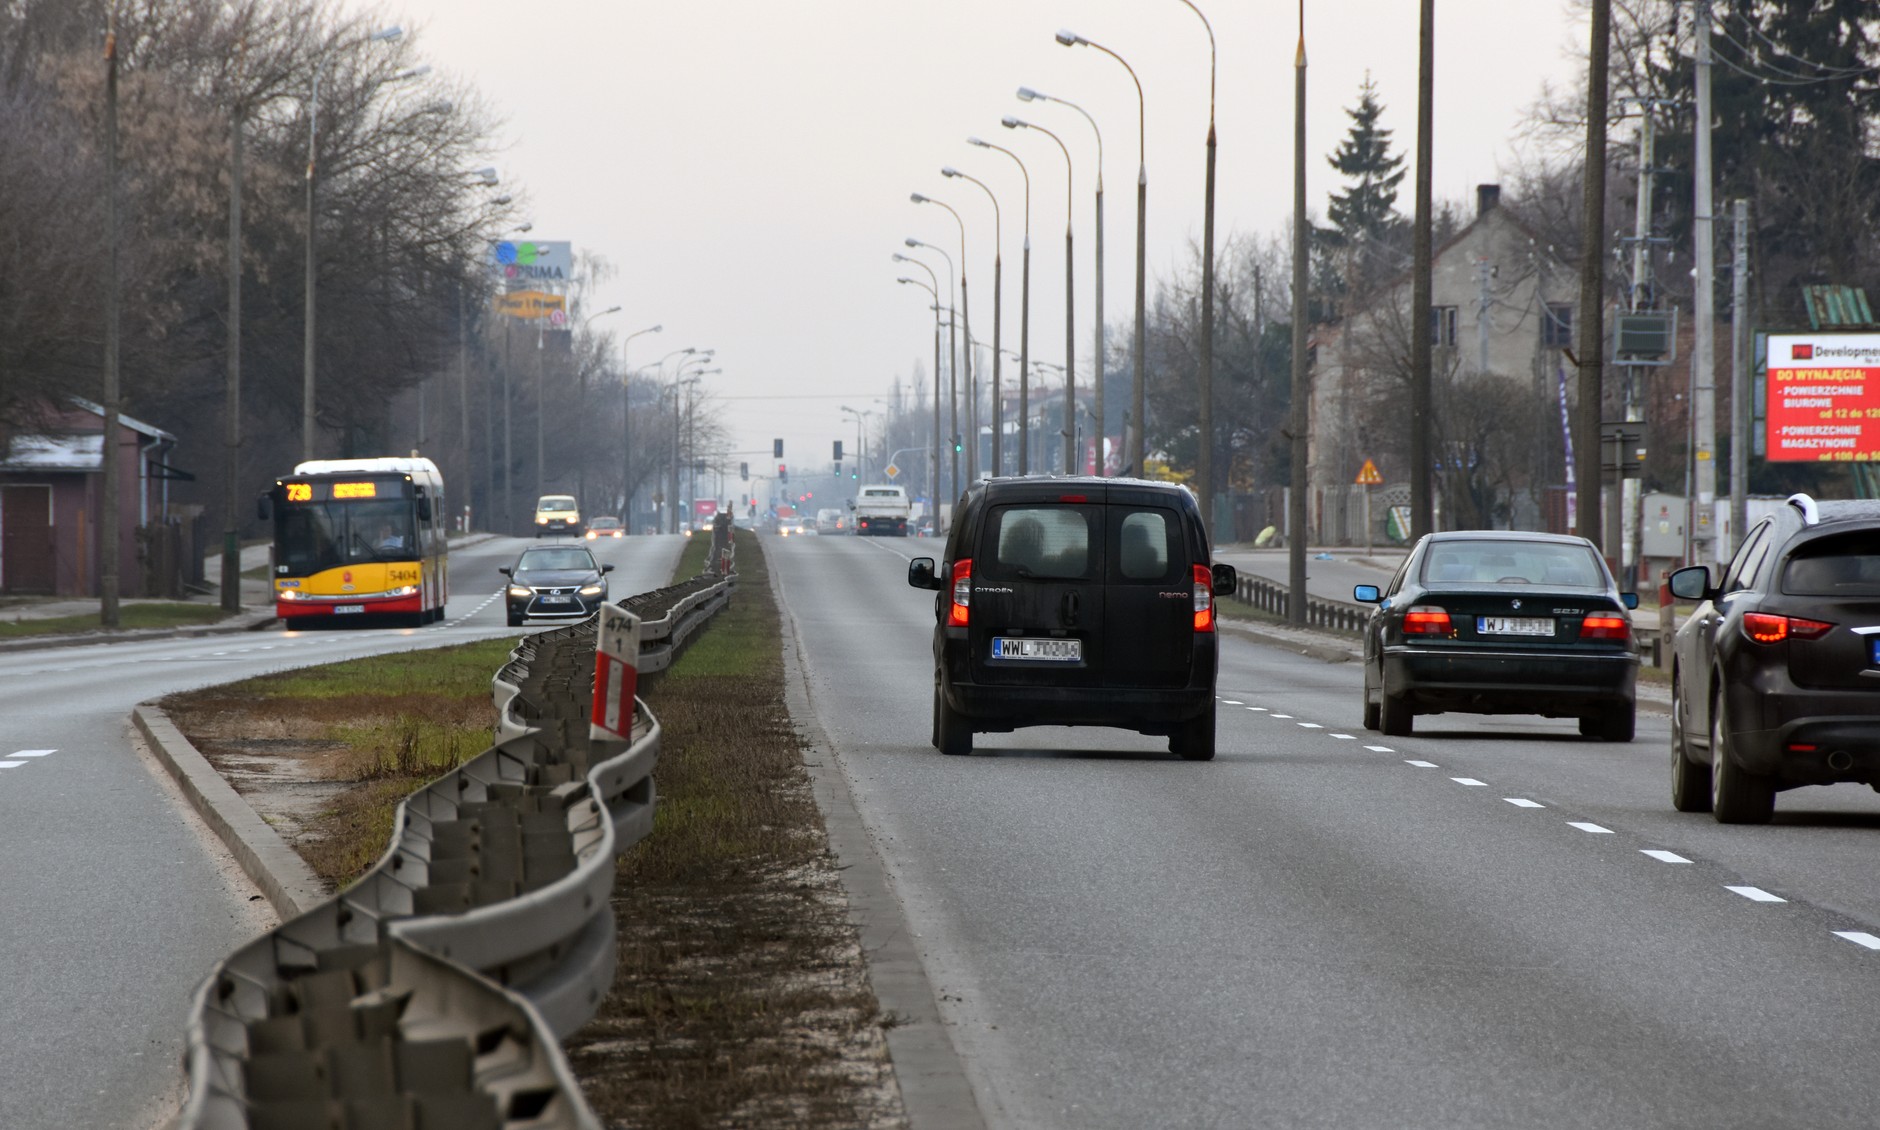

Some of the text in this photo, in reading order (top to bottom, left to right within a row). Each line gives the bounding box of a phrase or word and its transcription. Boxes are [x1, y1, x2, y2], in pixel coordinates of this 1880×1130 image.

[1815, 346, 1880, 358] Developme
[1777, 369, 1866, 383] DO WYNAJĘCIA:
[1784, 386, 1863, 395] POWIERZCHNIE
[1784, 398, 1832, 408] BIUROWE
[1819, 409, 1833, 418] od
[1835, 408, 1848, 418] 12
[1849, 408, 1863, 418] do
[1782, 425, 1862, 435] POWIERZCHNIE
[1781, 438, 1856, 448] MAGAZYNOWE
[1818, 451, 1832, 461] od
[1855, 451, 1869, 461] do
[390, 570, 417, 581] 5404
[1159, 591, 1188, 599] nemo
[606, 617, 632, 633] 474
[1486, 618, 1505, 631] WJ
[1002, 640, 1029, 656] WWL
